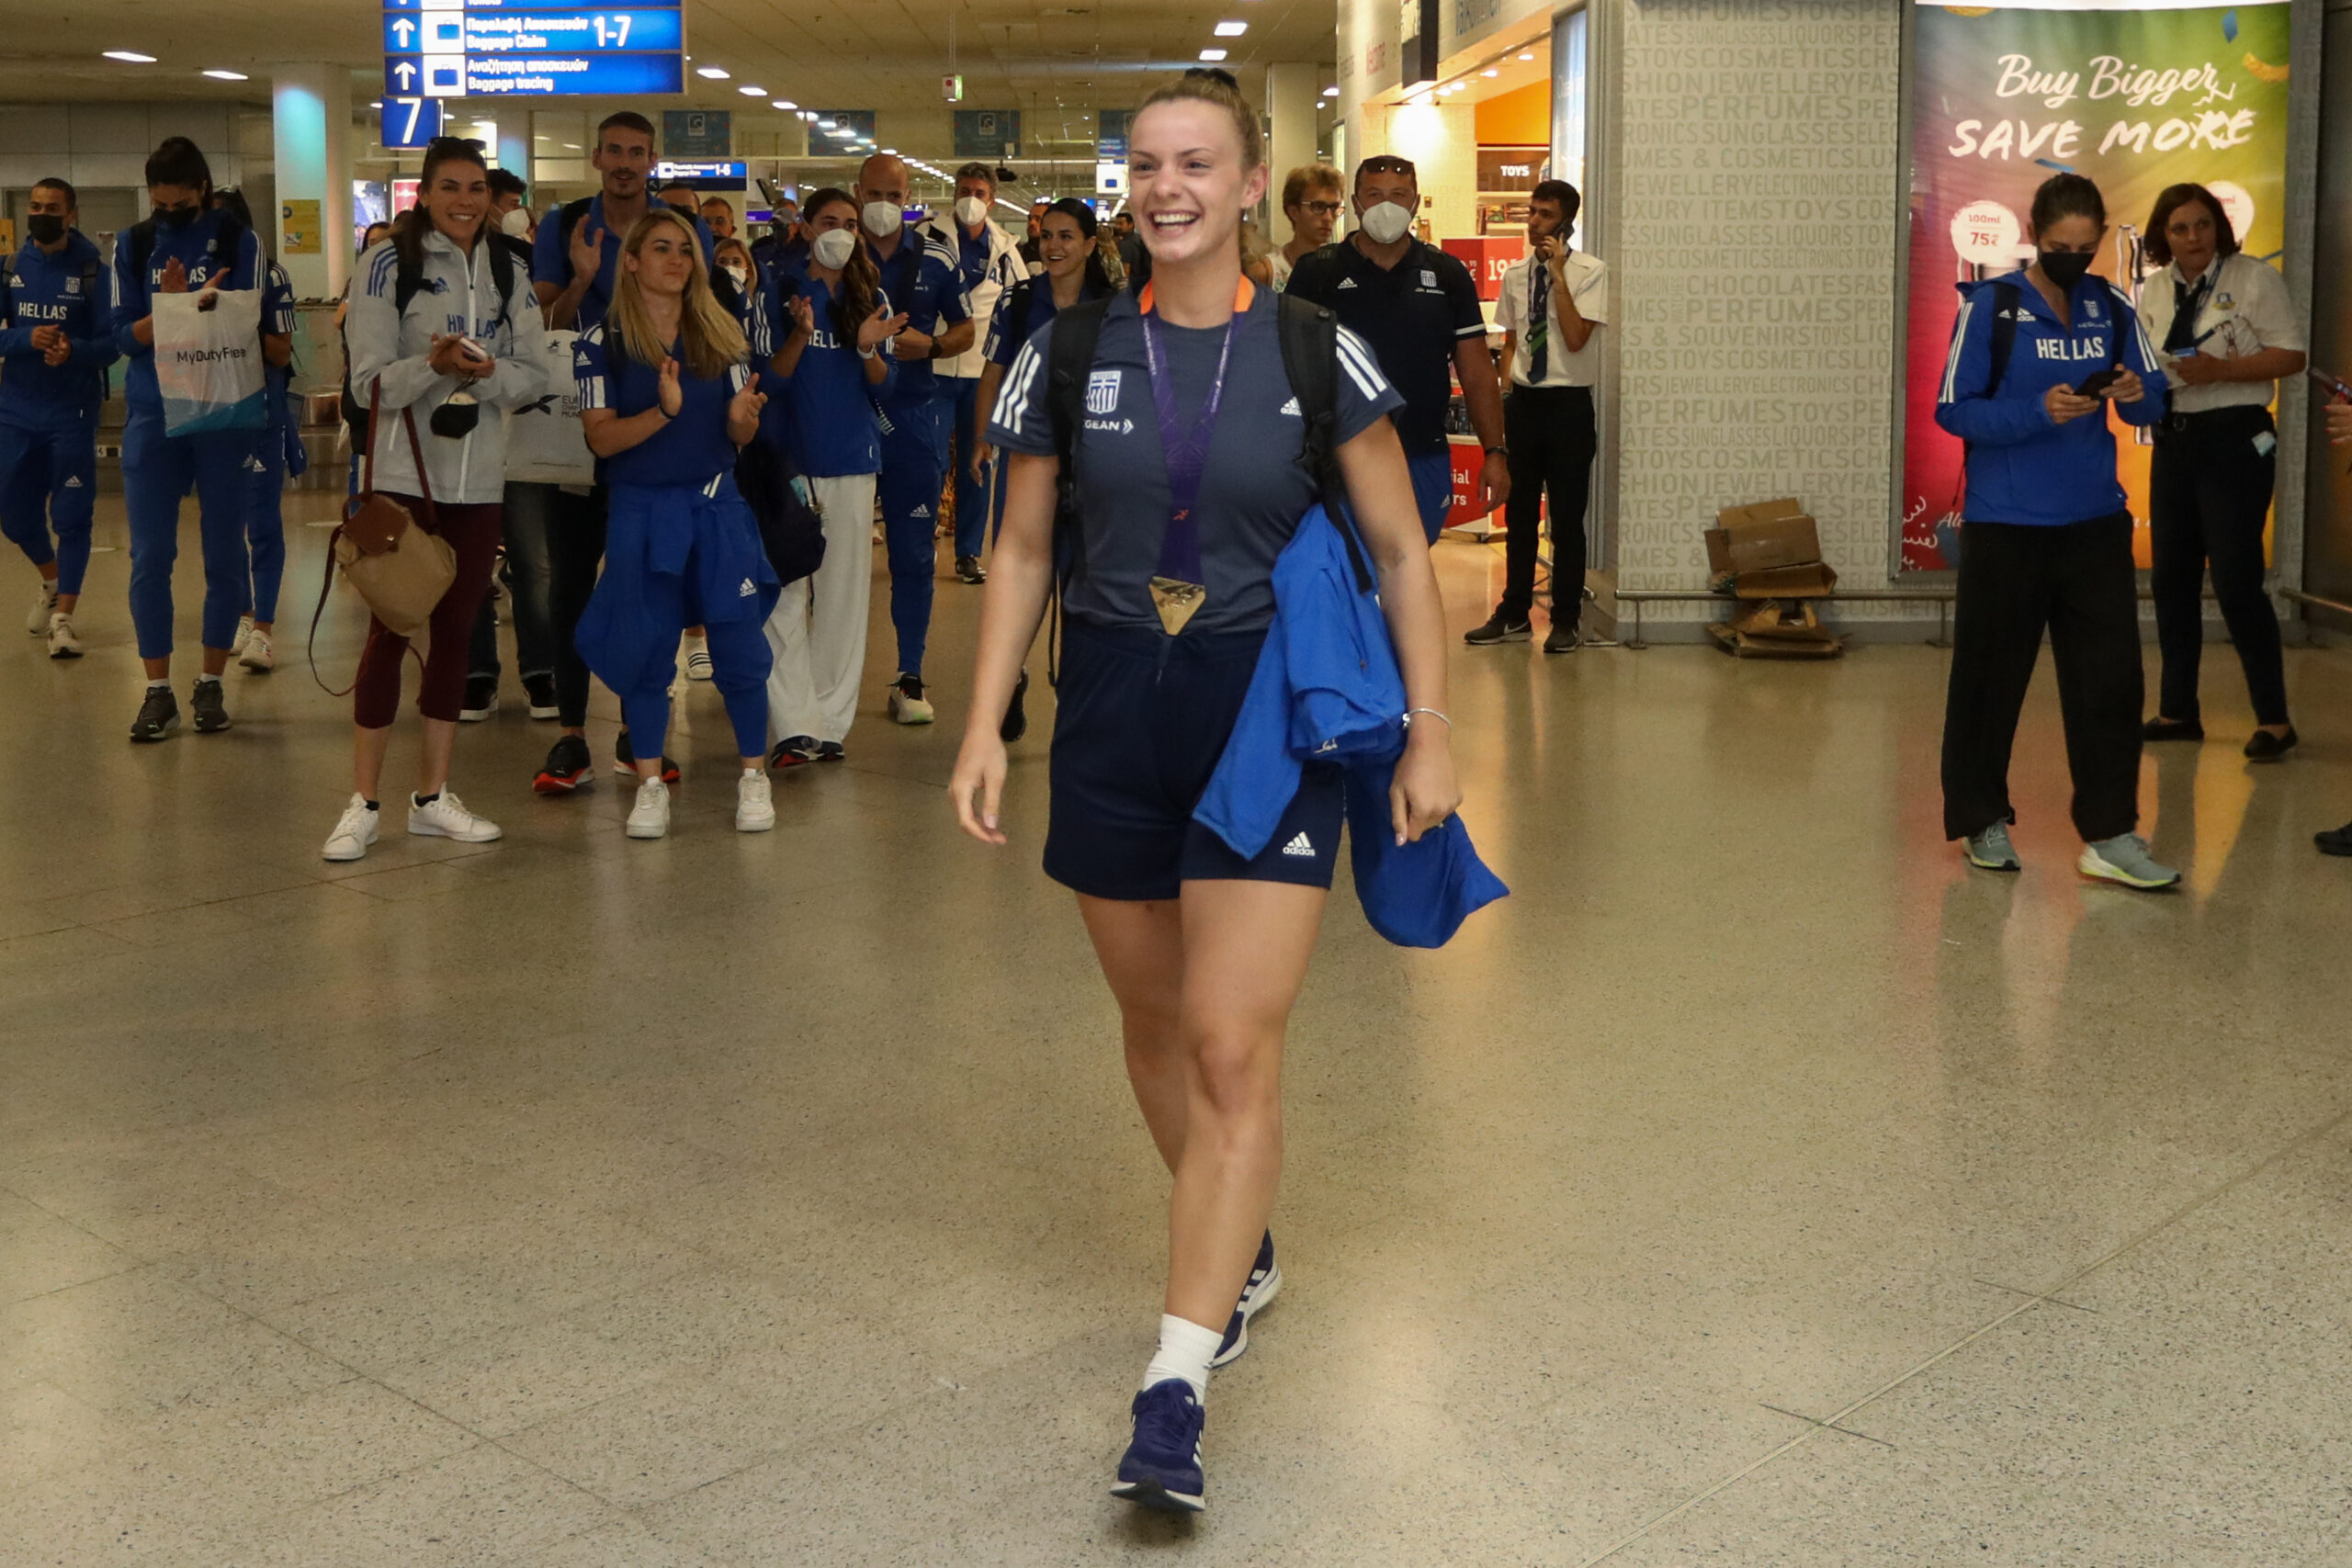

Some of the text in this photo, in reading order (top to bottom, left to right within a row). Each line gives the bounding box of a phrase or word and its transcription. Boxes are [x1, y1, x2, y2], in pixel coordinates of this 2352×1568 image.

[594, 16, 631, 47] 1-7
[514, 35, 548, 48] Claim
[468, 77, 514, 92] Baggage
[1996, 53, 2222, 109] Buy Bigger
[396, 97, 422, 144] 7
[1948, 109, 2257, 161] SAVE MORE
[1500, 165, 1530, 176] TOYS
[1969, 214, 2000, 223] 100ml
[18, 301, 68, 321] HELLAS
[176, 346, 246, 365] MyDutyFree
[2035, 336, 2106, 360] HELLAS
[1083, 419, 1120, 431] GEAN
[1283, 844, 1316, 857] adidas
